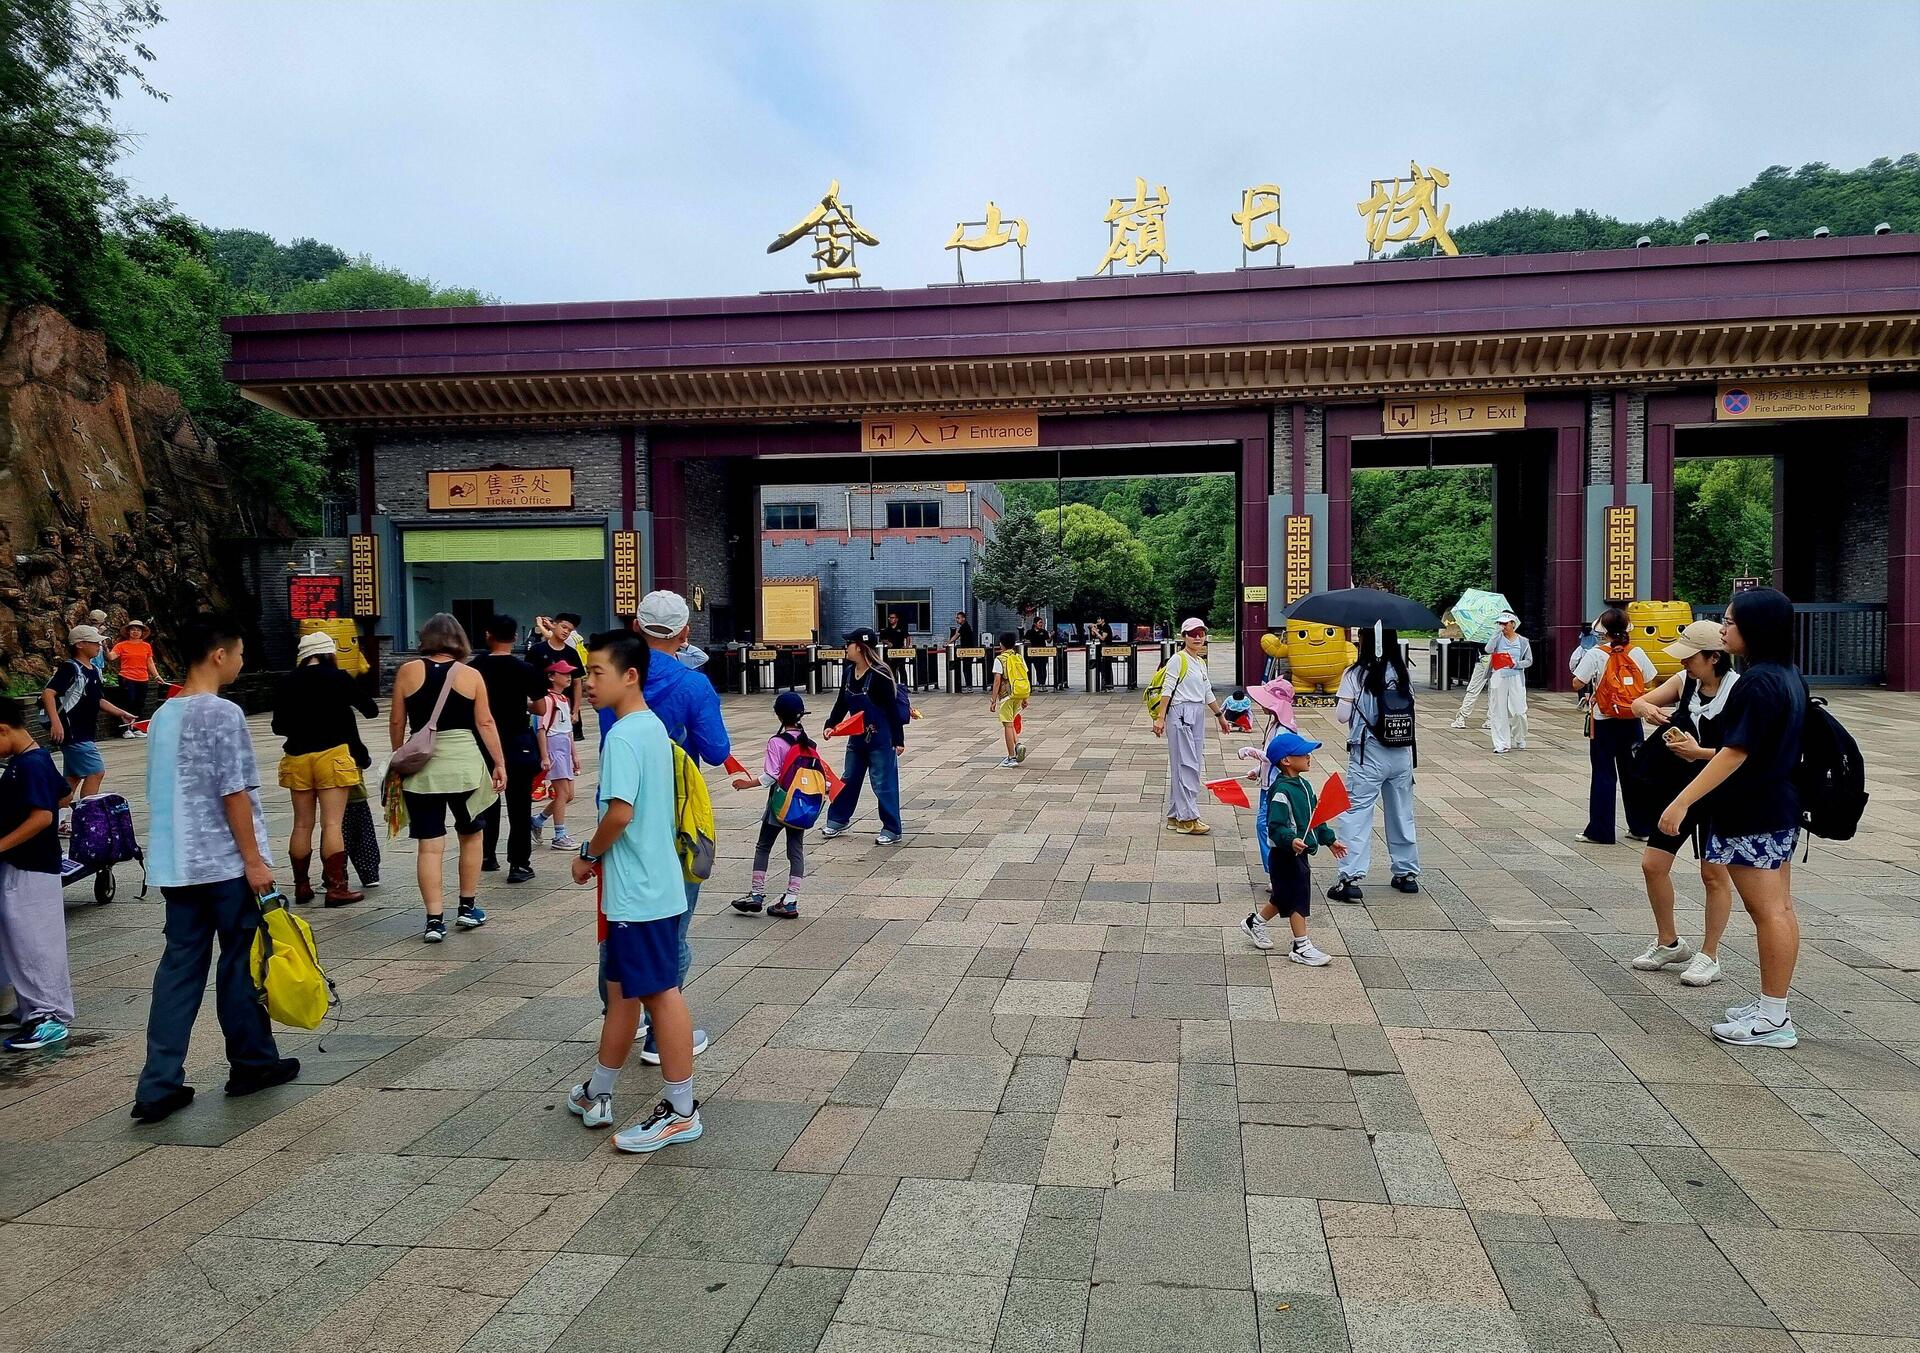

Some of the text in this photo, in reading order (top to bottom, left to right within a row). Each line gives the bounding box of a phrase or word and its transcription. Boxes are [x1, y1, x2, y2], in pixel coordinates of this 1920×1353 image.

[1430, 403, 1475, 425] 出口
[1487, 405, 1517, 419] Exit
[1809, 403, 1823, 411] Not
[1825, 402, 1856, 412] Parking
[904, 424, 959, 446] 入口
[970, 425, 1033, 439] Entrance
[484, 473, 551, 495] 售票处
[486, 495, 552, 505] Ticket Office
